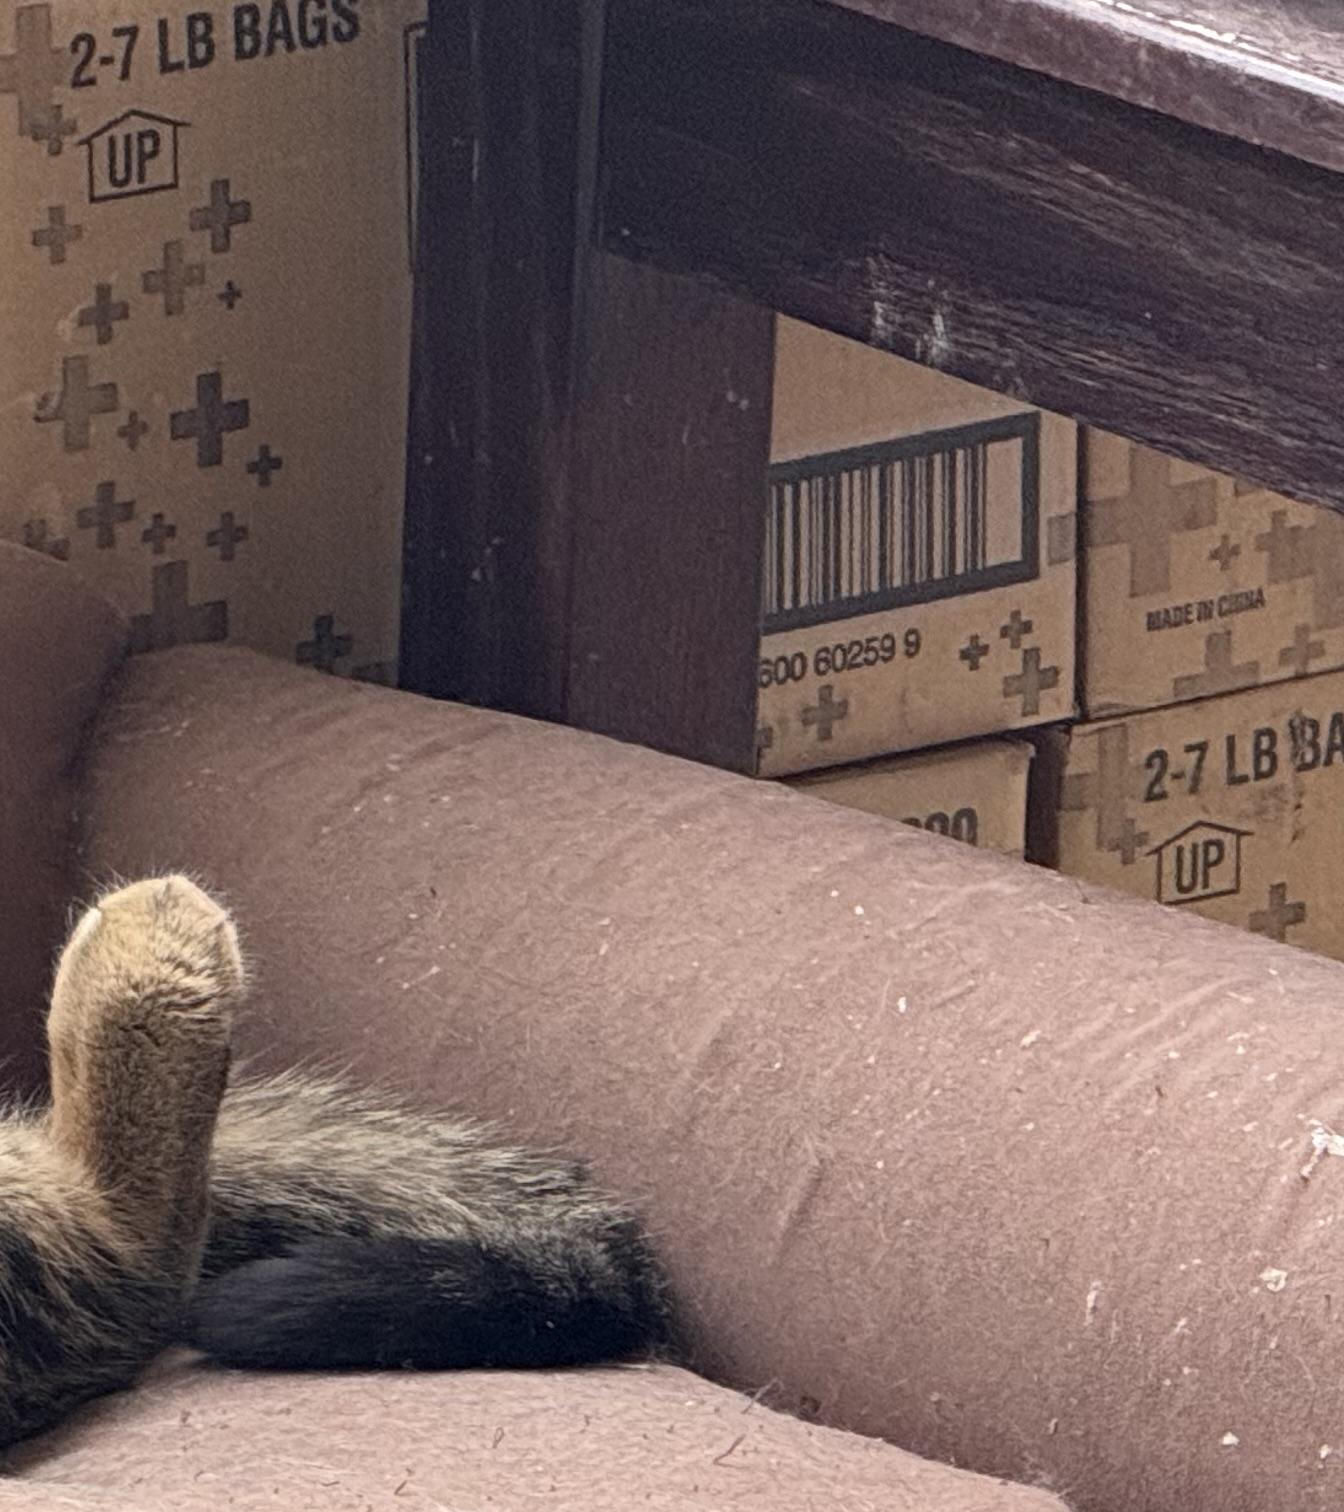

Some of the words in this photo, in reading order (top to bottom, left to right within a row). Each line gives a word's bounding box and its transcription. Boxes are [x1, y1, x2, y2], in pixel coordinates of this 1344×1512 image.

[70, 26, 139, 88] 2-7
[158, 12, 215, 74] LB
[234, 0, 359, 61] BAGS
[108, 129, 161, 187] UP
[1146, 604, 1194, 632] MADE
[1196, 600, 1214, 622] IN
[1218, 588, 1266, 617] CHINA
[814, 632, 896, 676] 60259
[903, 628, 921, 658] 9
[1143, 738, 1209, 803] 2-7
[1225, 726, 1278, 786] LB
[1175, 838, 1225, 894] UP
